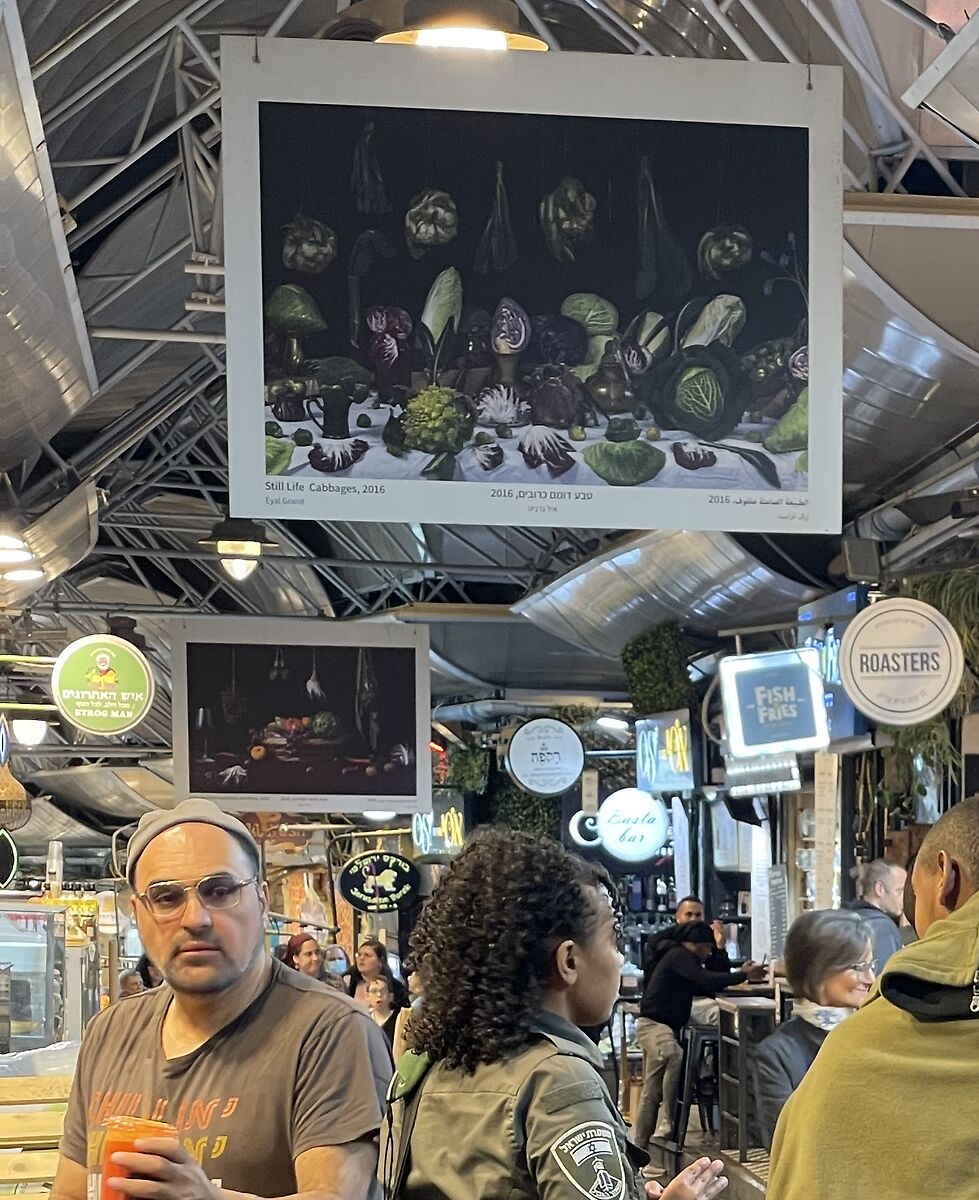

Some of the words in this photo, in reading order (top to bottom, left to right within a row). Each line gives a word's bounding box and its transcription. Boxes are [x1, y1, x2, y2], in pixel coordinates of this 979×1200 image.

[265, 481, 284, 491] Still
[286, 481, 305, 492] Life
[309, 483, 360, 495] Cabbages,
[362, 484, 386, 494] 2016
[490, 488, 514, 498] 2016
[516, 490, 548, 500] כרובים,
[549, 490, 572, 500] דומם
[574, 491, 593, 500] טבע
[708, 495, 731, 504] 2016
[859, 651, 941, 673] ROASTERS
[121, 691, 144, 701] איש
[754, 685, 797, 706] FISH
[74, 708, 108, 718] ETROG
[110, 710, 133, 718] MAN
[757, 703, 798, 724] FRIES
[585, 1128, 612, 1139] משטרת
[558, 1132, 586, 1154] ישראל
